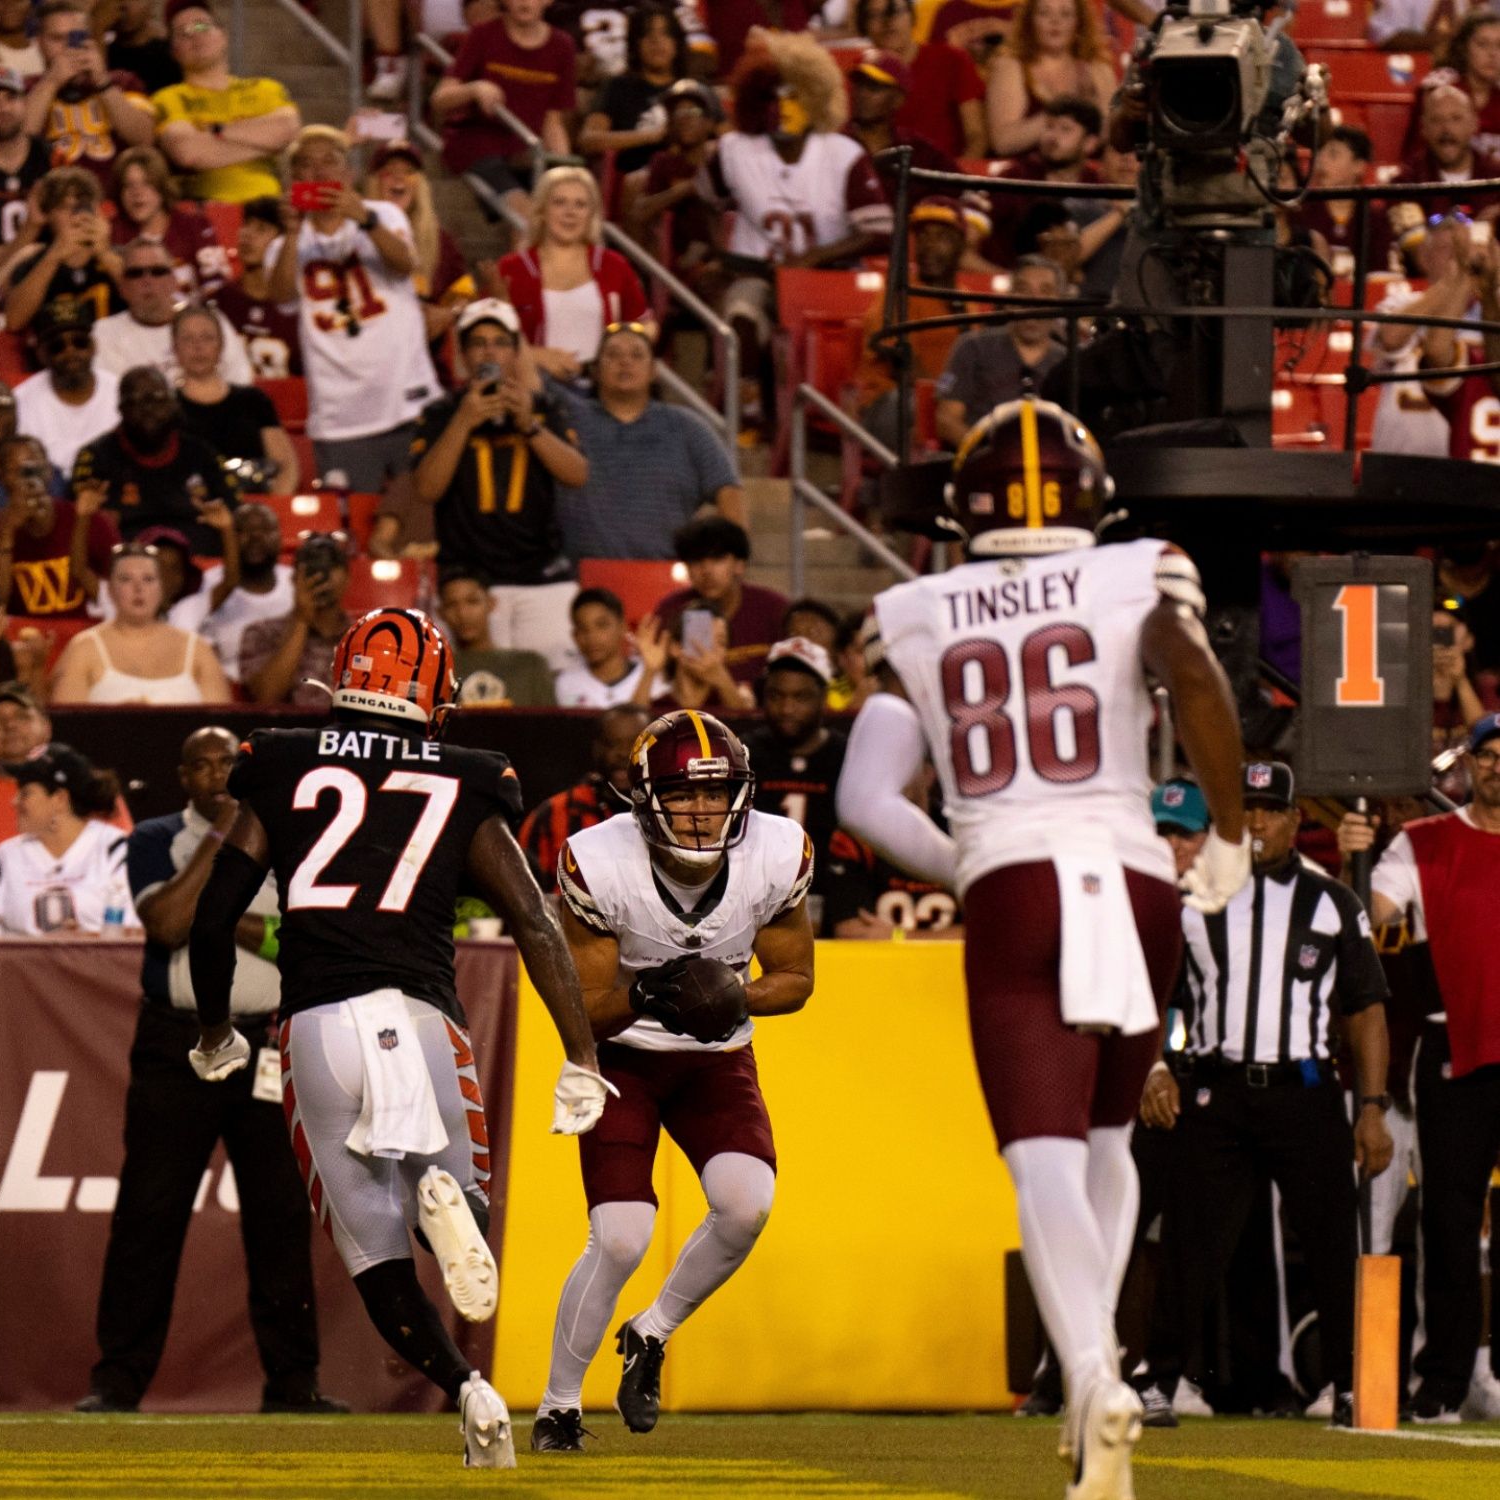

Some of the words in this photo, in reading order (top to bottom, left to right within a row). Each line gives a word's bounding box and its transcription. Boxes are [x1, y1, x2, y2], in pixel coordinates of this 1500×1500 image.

[303, 259, 389, 333] 91
[943, 567, 1081, 630] TINSLEY
[1332, 585, 1385, 706] 1
[341, 694, 408, 713] BENGALS
[361, 671, 392, 692] 27
[940, 623, 1101, 798] 86
[318, 730, 441, 762] BATTLE
[285, 765, 461, 913] 27
[642, 951, 745, 964] WATON
